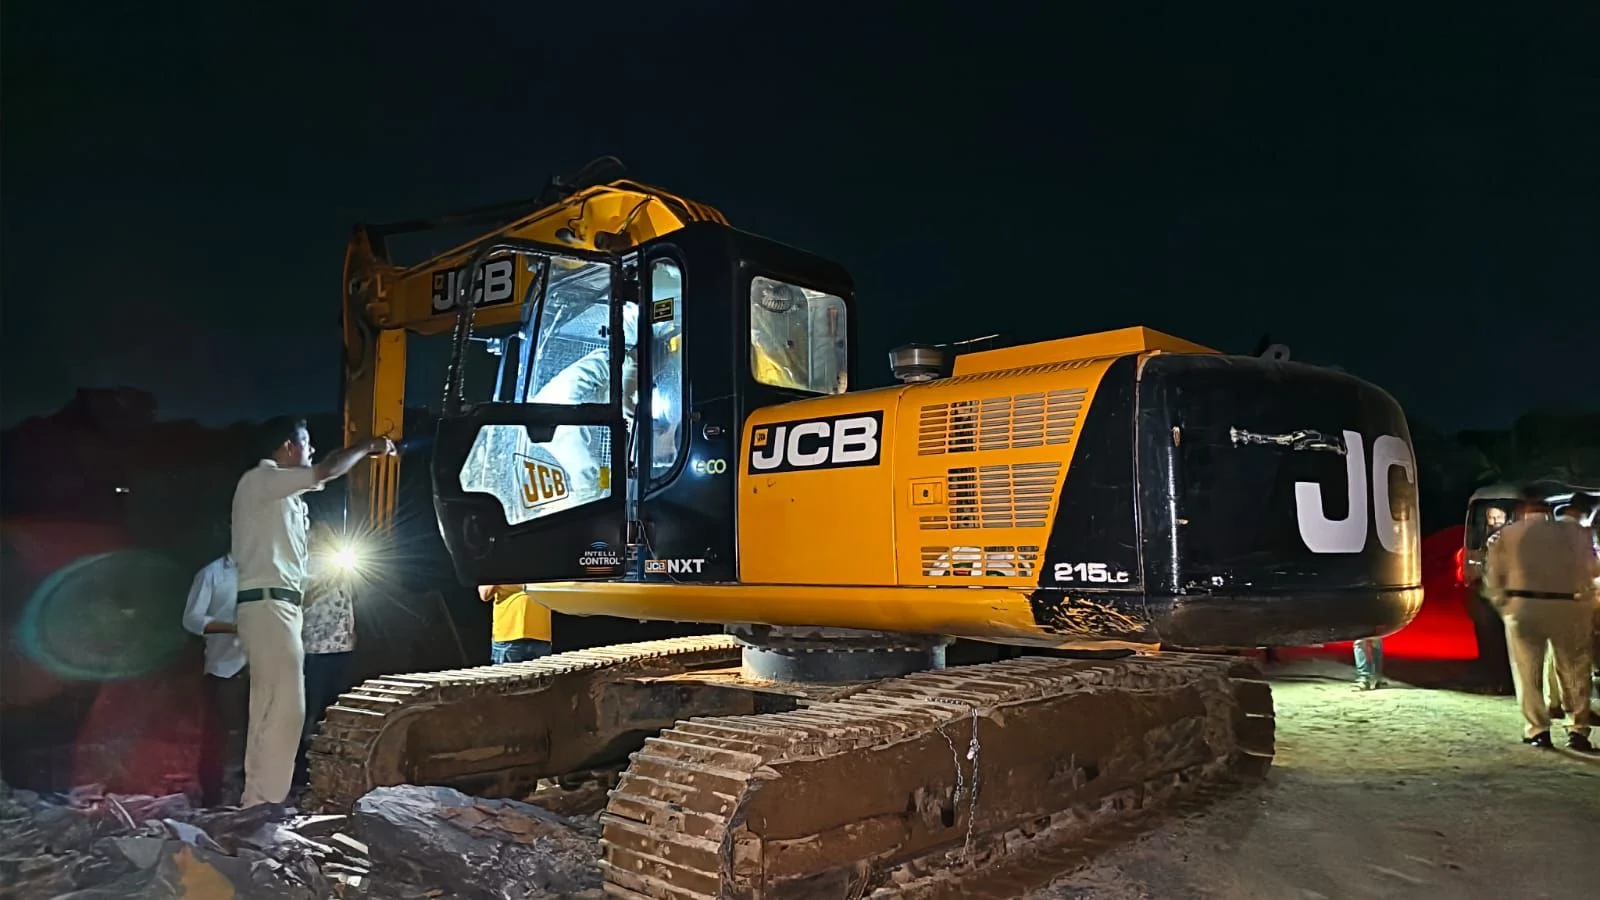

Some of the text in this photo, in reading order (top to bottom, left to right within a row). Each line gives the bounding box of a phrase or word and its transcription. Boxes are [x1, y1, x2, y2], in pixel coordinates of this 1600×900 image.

[752, 416, 878, 470] JCB
[523, 460, 566, 503] JCB
[579, 557, 621, 566] CONTROL
[646, 559, 705, 573] JCB NXT
